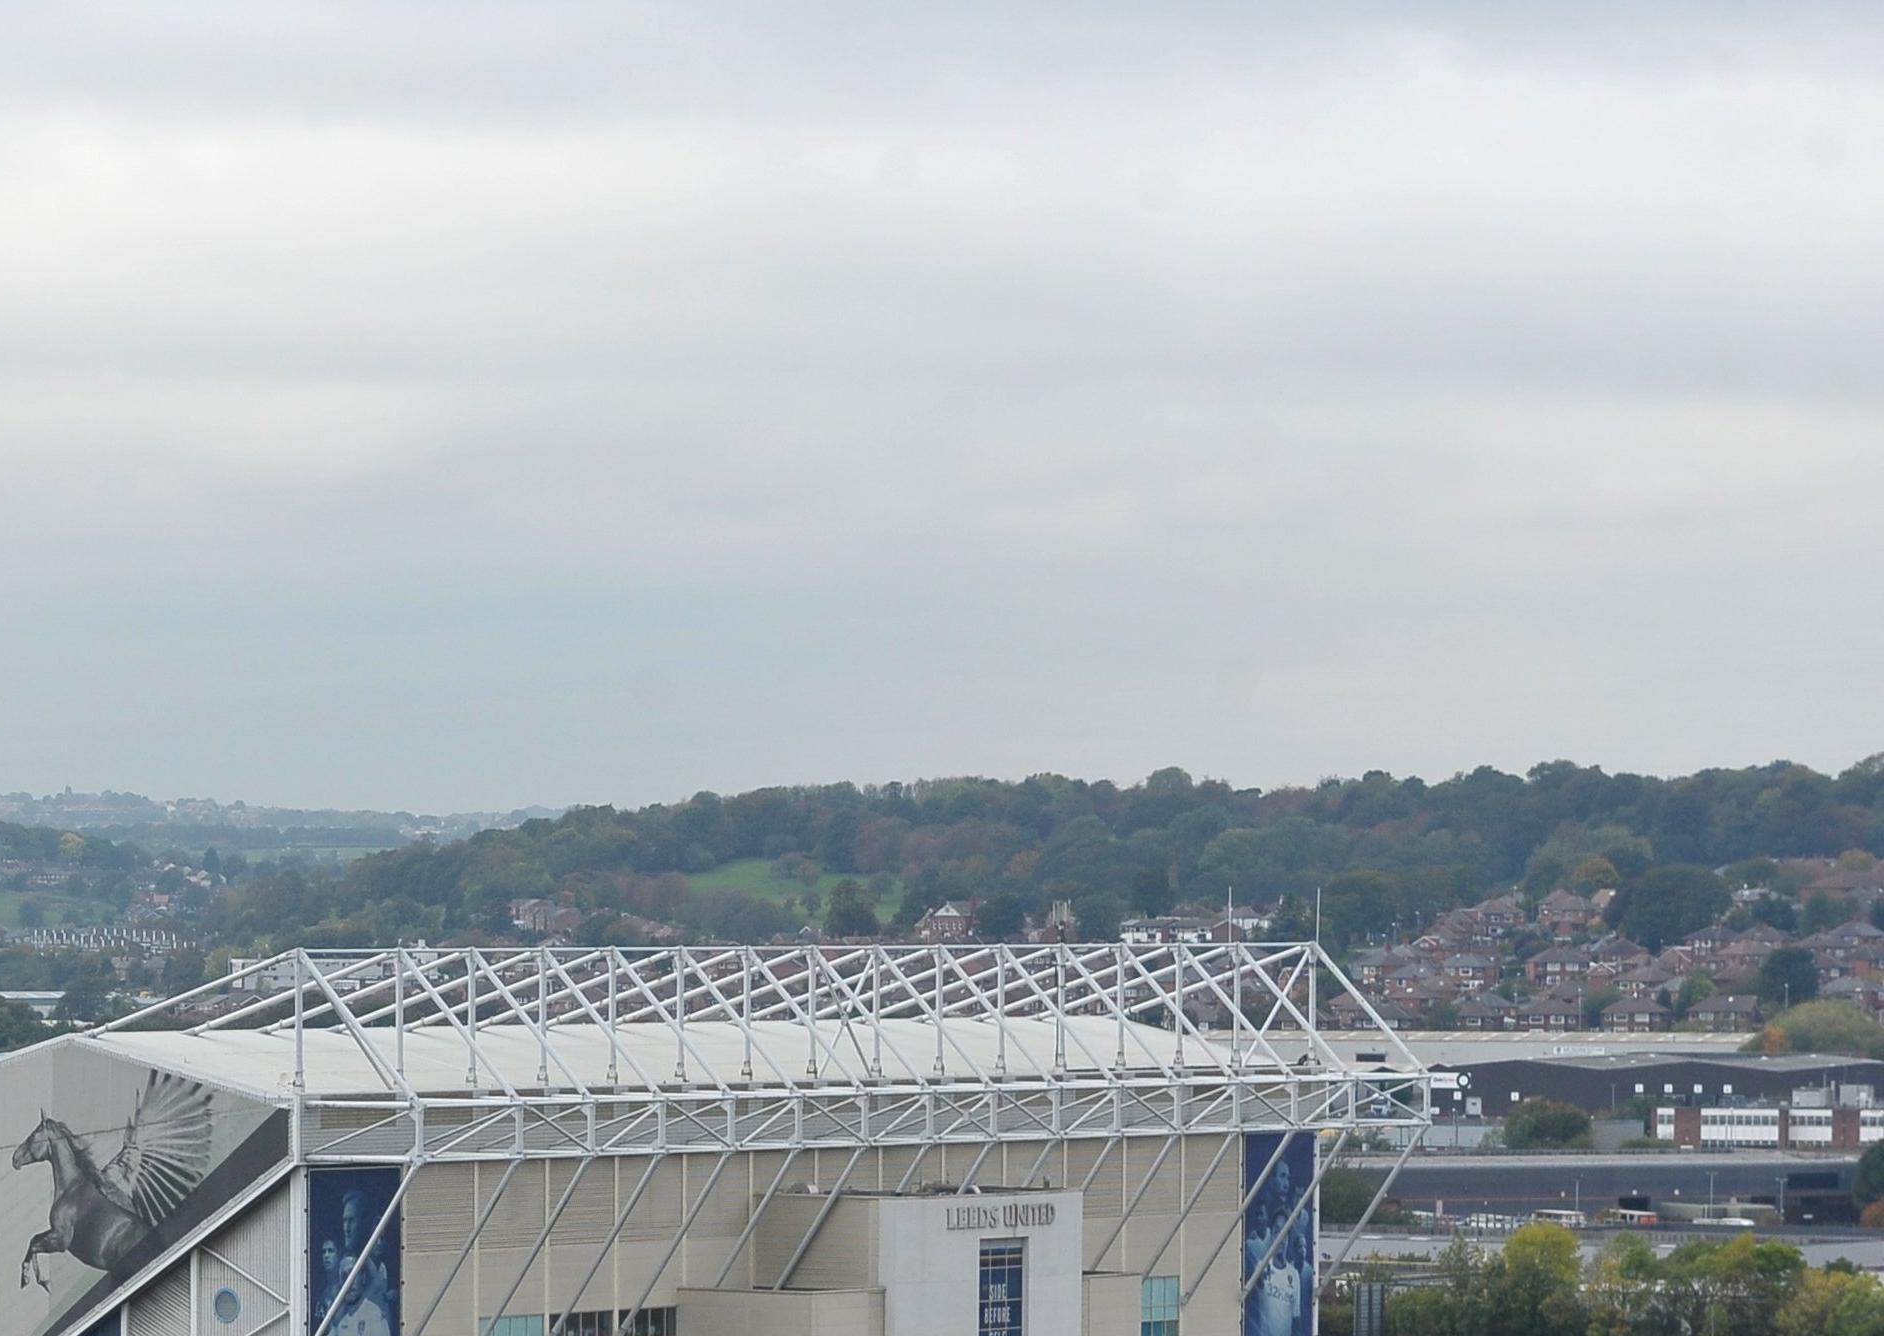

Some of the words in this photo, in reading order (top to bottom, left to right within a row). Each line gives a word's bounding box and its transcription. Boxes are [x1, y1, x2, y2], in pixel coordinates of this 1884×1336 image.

[946, 1207, 998, 1230] LEEDS
[1002, 1202, 1056, 1228] UNITED
[988, 1283, 1007, 1300] SIDE
[984, 1306, 1011, 1324] BEFORE
